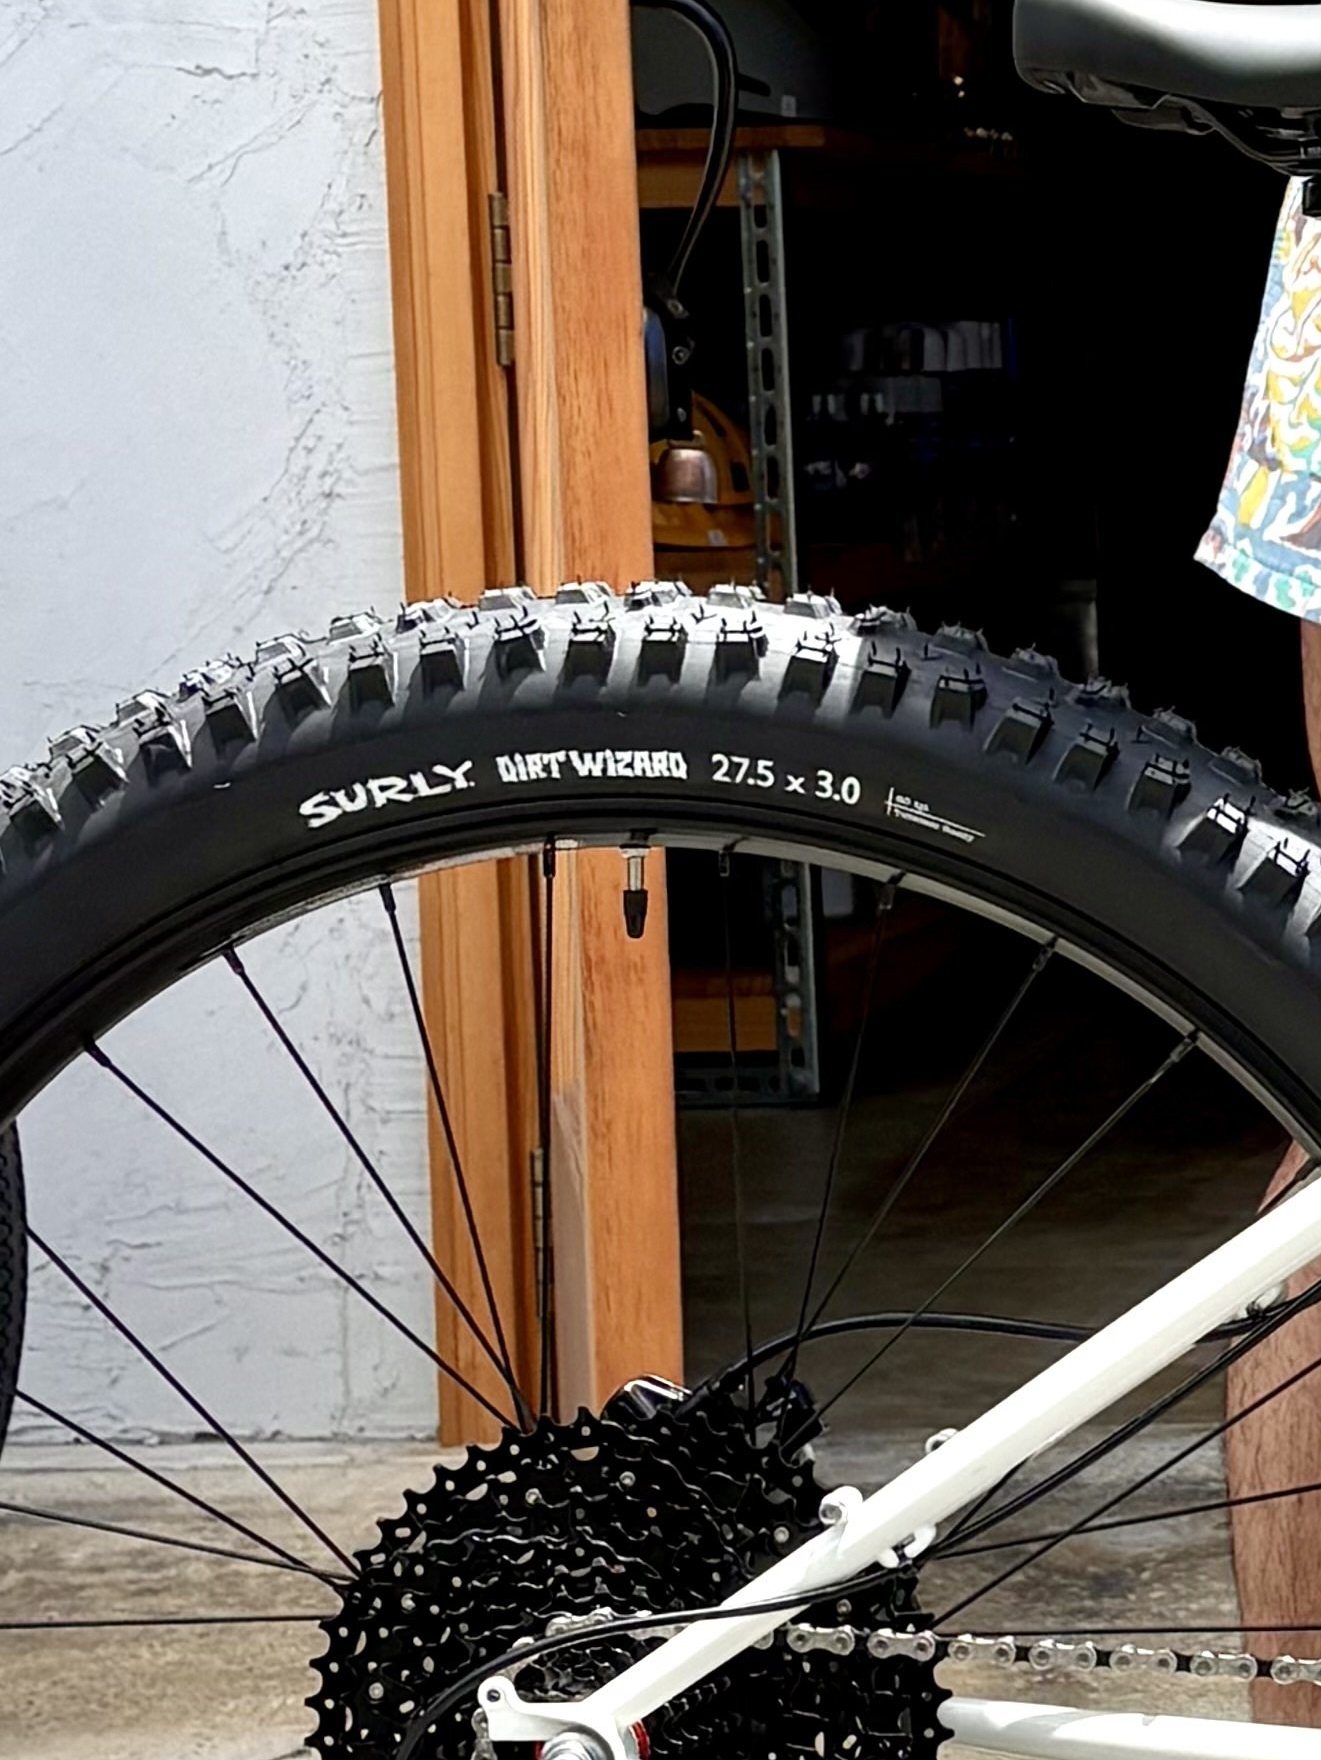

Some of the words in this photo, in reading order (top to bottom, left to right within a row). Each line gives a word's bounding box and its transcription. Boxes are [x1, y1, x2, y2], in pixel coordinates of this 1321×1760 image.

[300, 761, 475, 828] SURLY
[495, 749, 567, 784] DIRT
[568, 748, 688, 780] WIZARD
[710, 753, 776, 789] 27.5
[784, 772, 805, 795] x
[814, 770, 861, 806] 3.0
